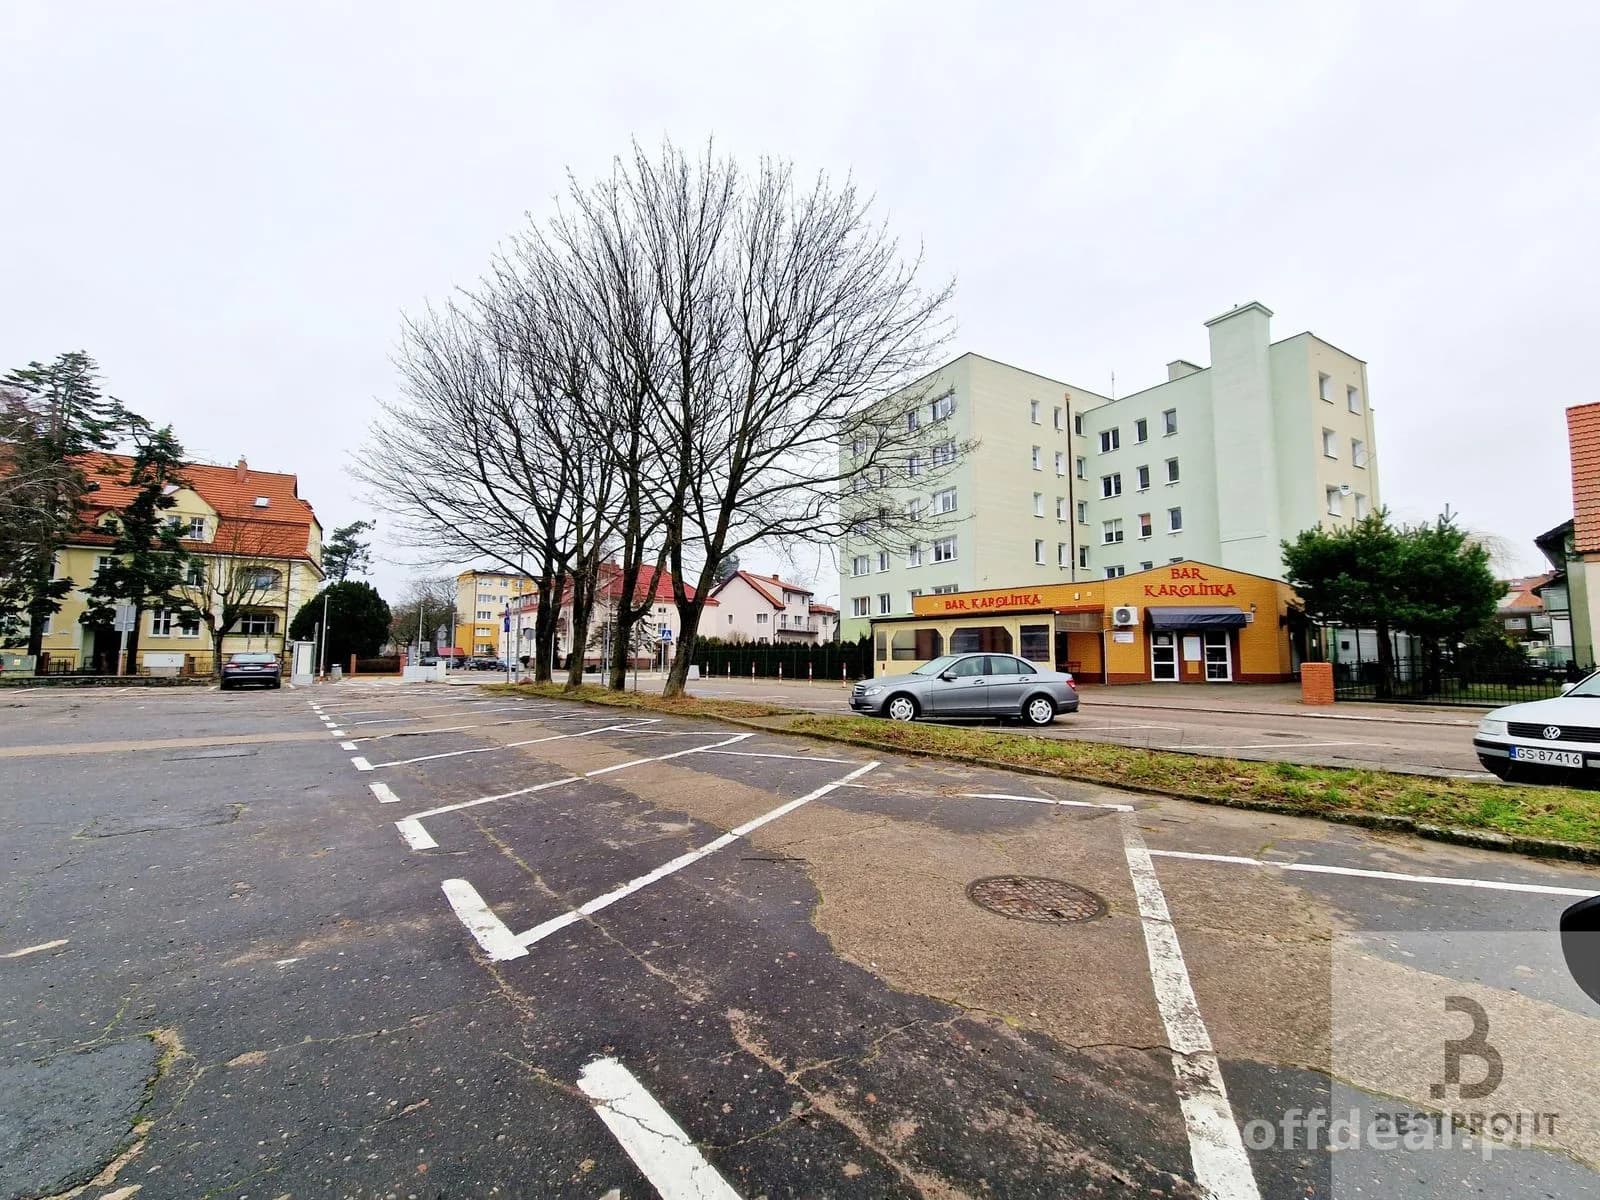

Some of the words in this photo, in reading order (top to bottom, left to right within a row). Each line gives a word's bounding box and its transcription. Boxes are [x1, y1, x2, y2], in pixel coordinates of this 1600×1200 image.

[1171, 567, 1208, 580] BAR
[945, 599, 970, 610] BAR
[1517, 749, 1535, 760] GS
[1538, 751, 1580, 764] 87416
